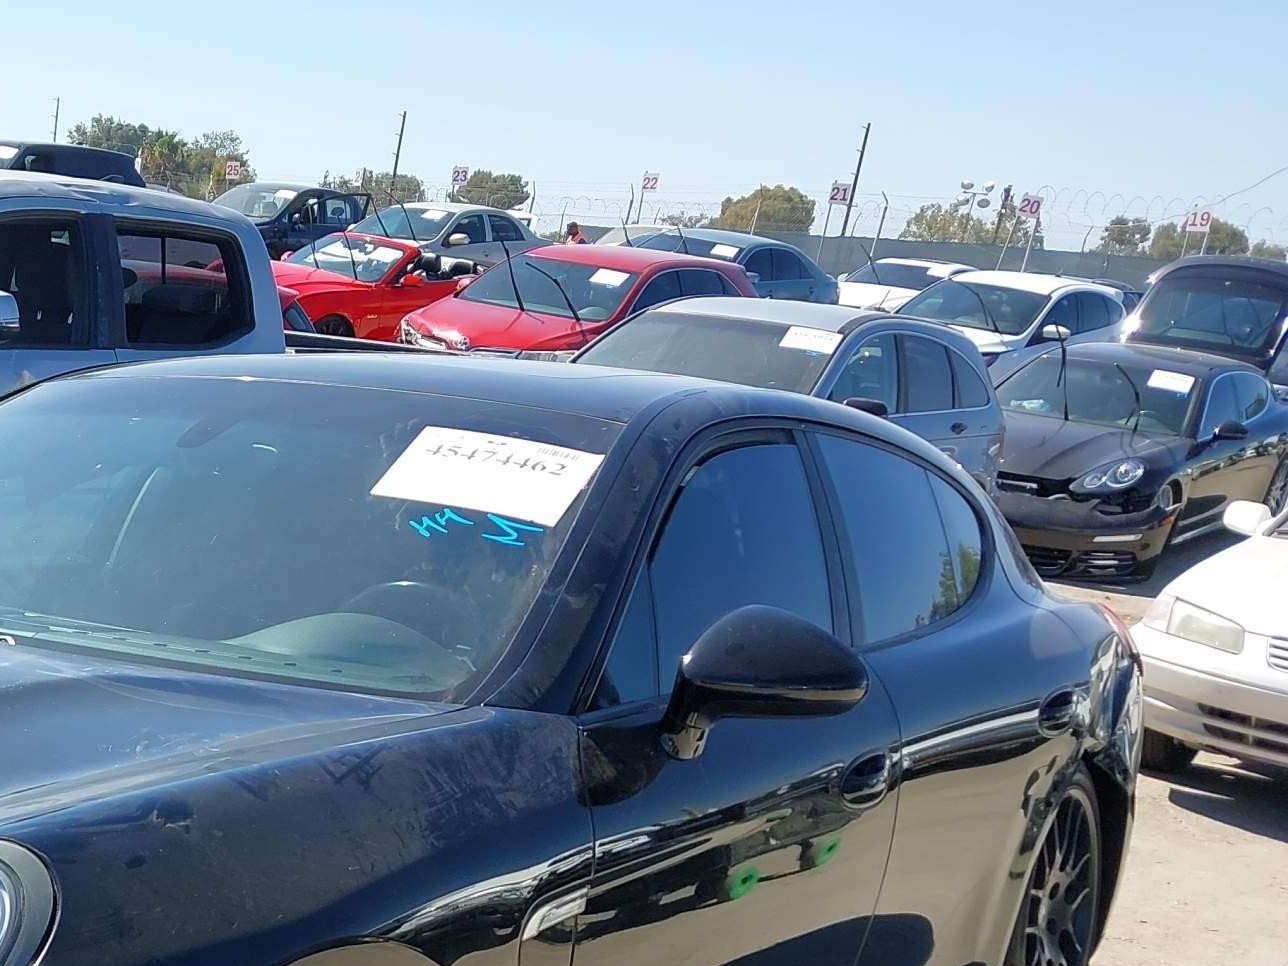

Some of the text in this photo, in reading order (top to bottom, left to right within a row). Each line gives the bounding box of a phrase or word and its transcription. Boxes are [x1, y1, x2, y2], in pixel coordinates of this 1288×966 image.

[227, 164, 240, 176] 25
[452, 170, 469, 183] 23
[643, 176, 658, 190] 22
[831, 187, 849, 201] 21
[1019, 198, 1041, 215] 20
[1189, 211, 1211, 227] 19
[426, 443, 567, 476] 45474462
